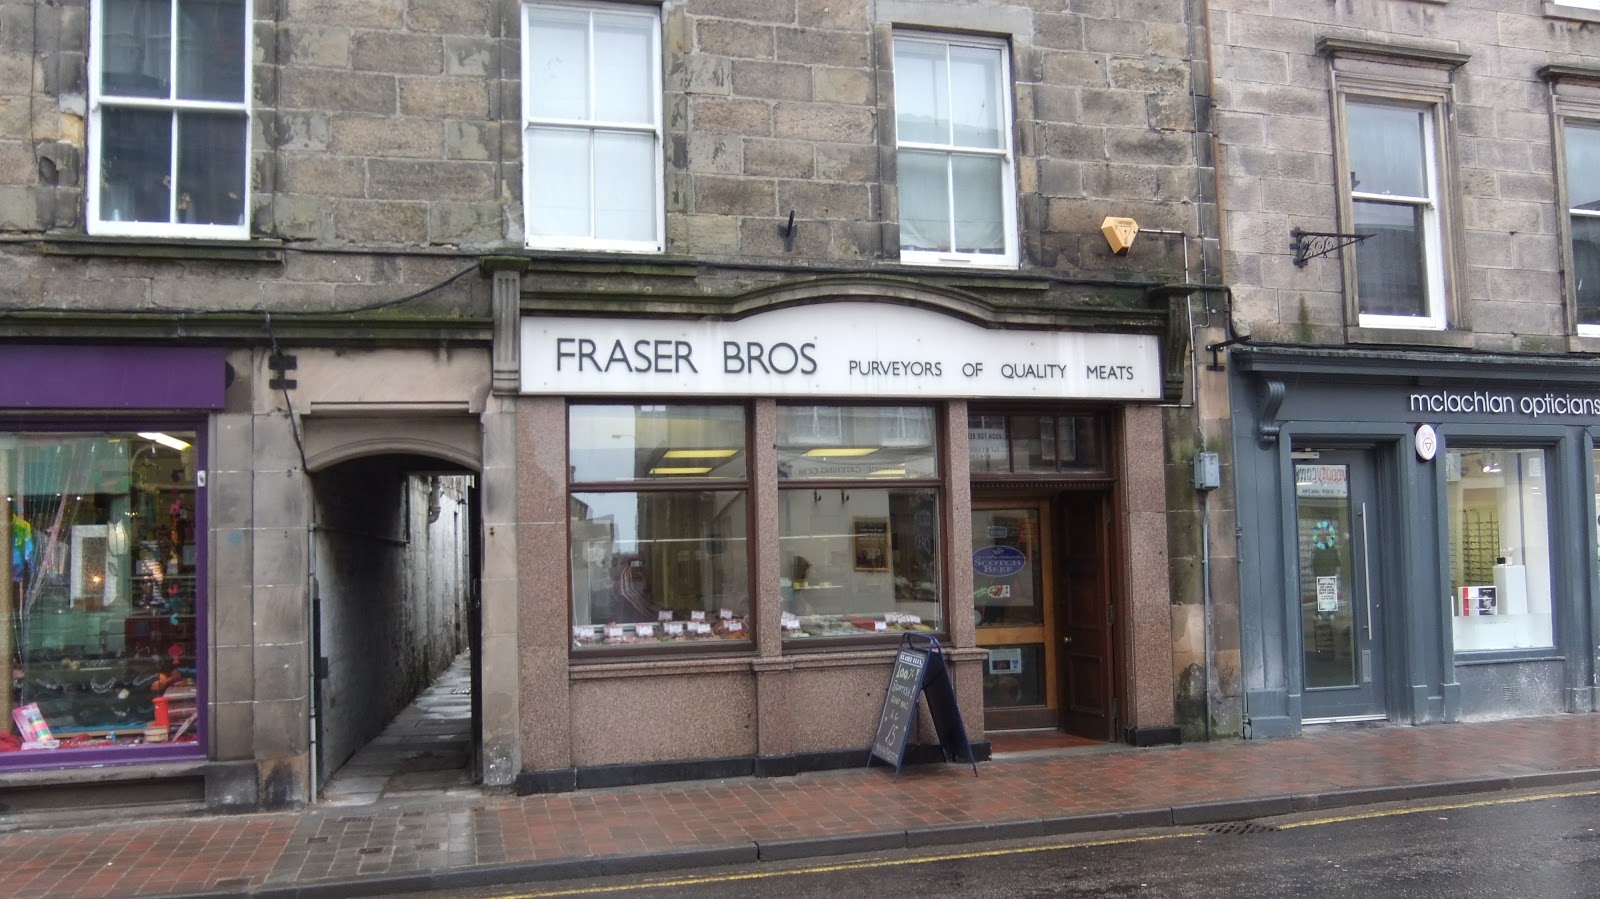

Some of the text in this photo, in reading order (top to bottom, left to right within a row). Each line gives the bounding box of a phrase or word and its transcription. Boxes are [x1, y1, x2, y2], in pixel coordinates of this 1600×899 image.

[556, 338, 818, 375] FRASER BROS
[849, 360, 1134, 380] PURVEYORS OF QUALITY MEATS
[1410, 391, 1600, 418] mclachlan opticians
[984, 565, 1013, 573] BEEF
